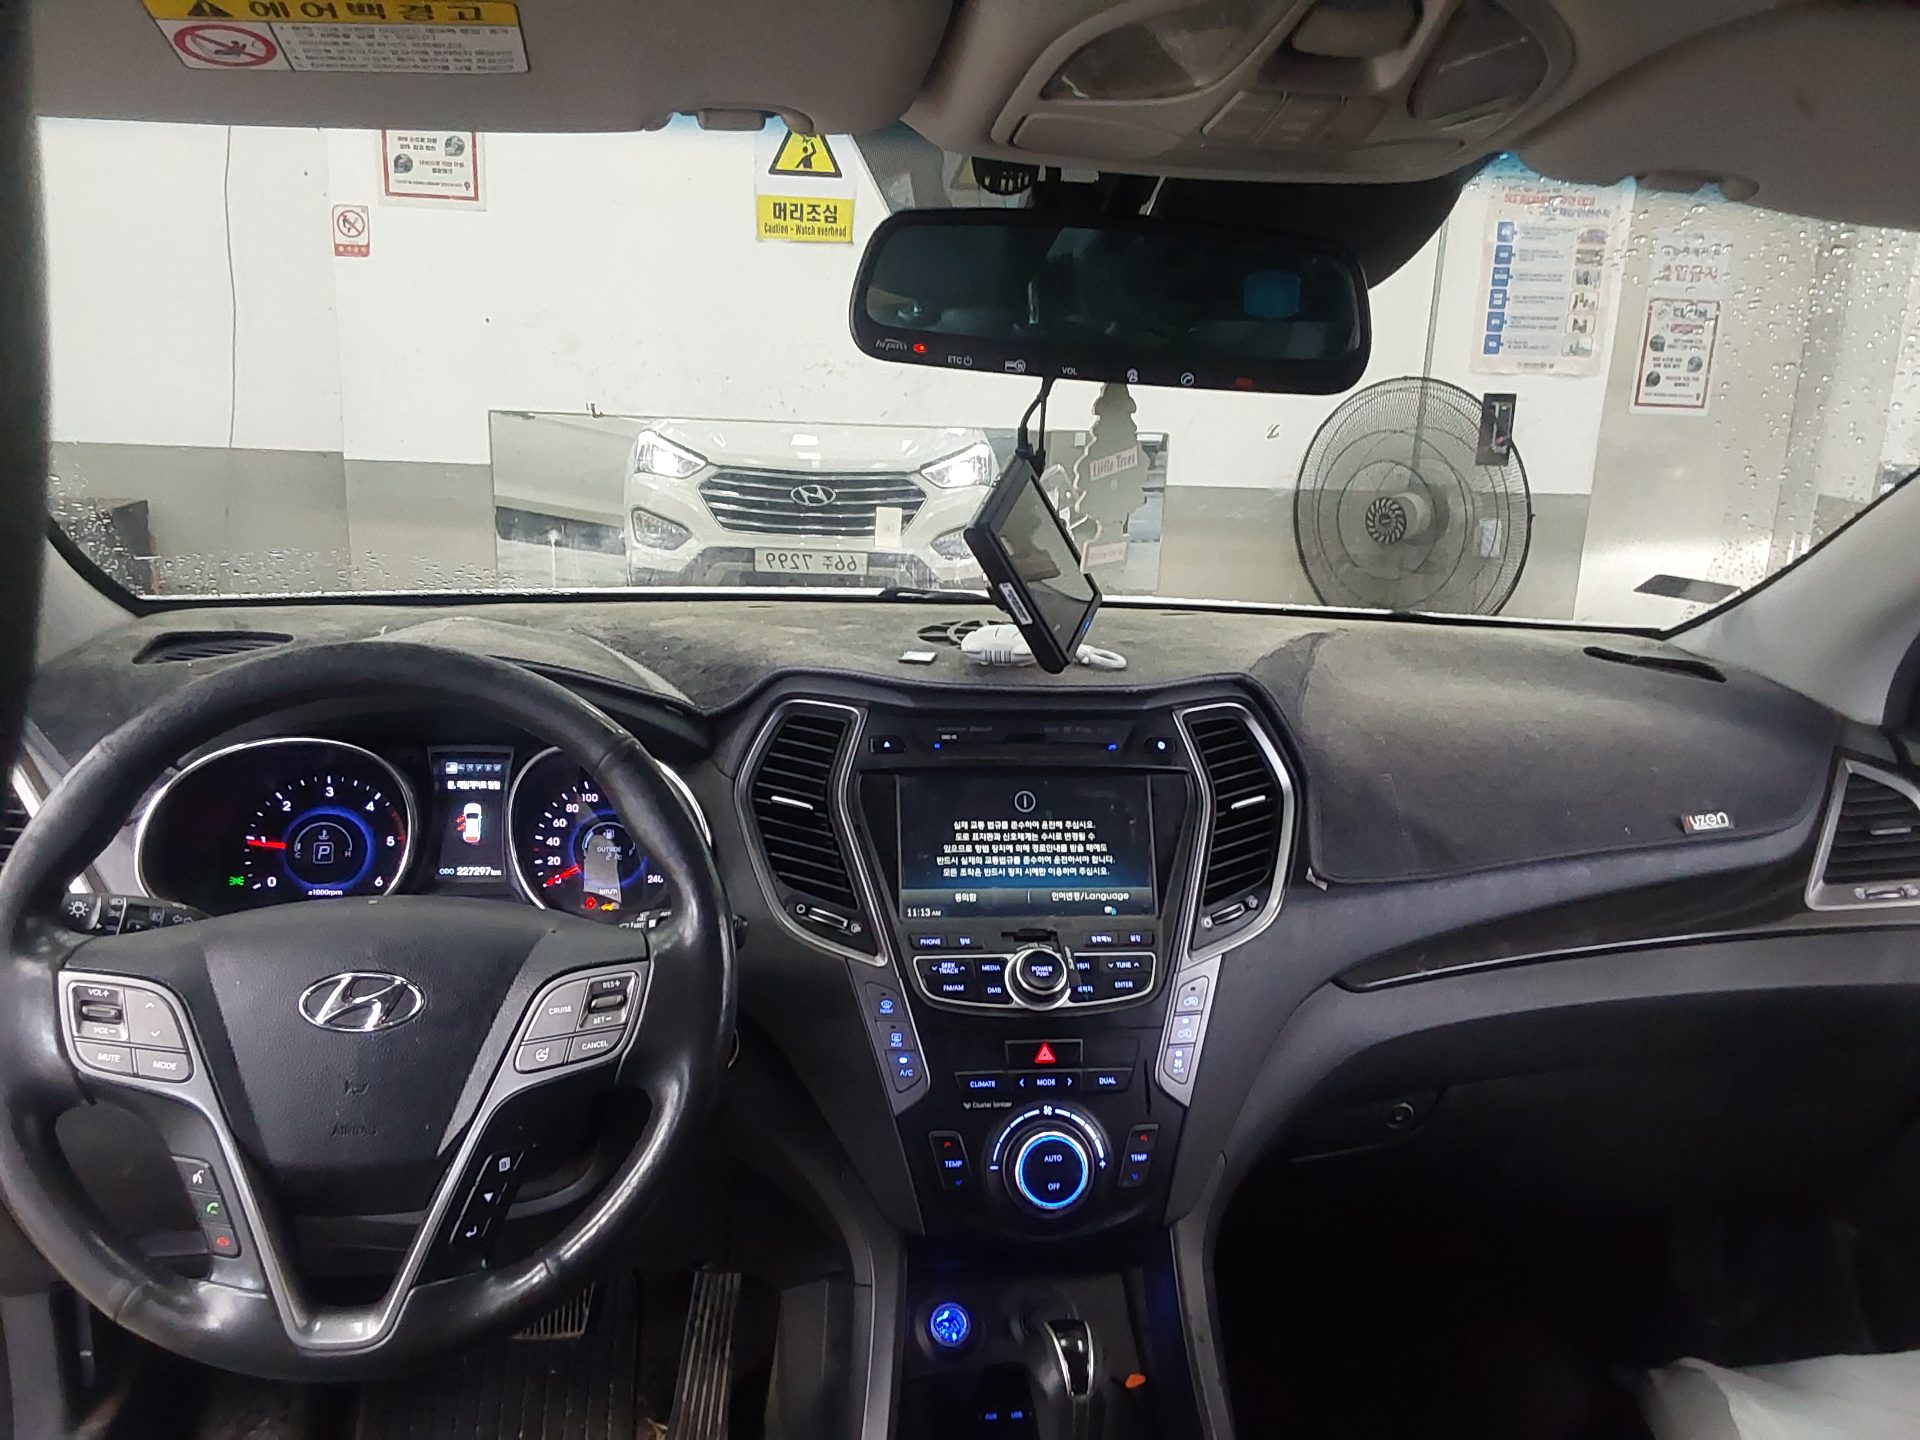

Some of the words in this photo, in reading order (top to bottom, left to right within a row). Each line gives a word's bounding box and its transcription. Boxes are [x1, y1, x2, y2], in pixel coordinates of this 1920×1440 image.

[773, 202, 838, 223] 머리조심
[764, 222, 789, 235] Caution
[795, 224, 816, 236] Watch
[817, 226, 847, 238] overhead
[947, 355, 963, 364] ETC
[1061, 366, 1078, 375] VOL
[1093, 459, 1115, 479] Little
[325, 786, 335, 797] 3
[581, 793, 599, 802] 100
[282, 801, 292, 811] 2
[365, 801, 375, 812] 4
[565, 803, 579, 813] 80
[552, 818, 567, 827] 60
[386, 836, 395, 846] 5
[1088, 831, 1096, 841] 수
[546, 837, 560, 846] 40
[317, 846, 331, 860] P
[547, 857, 561, 866] 20
[936, 856, 958, 866] 반드시
[456, 866, 492, 876] 227297
[984, 867, 1006, 877] 반드시
[1079, 867, 1110, 876] 주십시오.
[267, 876, 277, 887] 0
[374, 876, 384, 887] 6
[647, 874, 664, 884] 240
[907, 907, 931, 917] 11:13
[1031, 965, 1053, 973] POWER
[943, 984, 965, 992] FM/AM
[1114, 981, 1134, 989] ENTER
[548, 1005, 572, 1015] CRUISE
[581, 1040, 609, 1051] CANCEL
[97, 1052, 121, 1062] MUTE
[152, 1060, 177, 1070] MODE
[900, 1068, 914, 1076] A/C
[969, 1080, 996, 1088] CLIMATE
[1099, 1077, 1117, 1085] DUAL
[1044, 1154, 1063, 1162] AUTO
[1130, 1154, 1148, 1162] TEMP
[944, 1160, 963, 1168] TEMP
[1047, 1183, 1060, 1191] OFF
